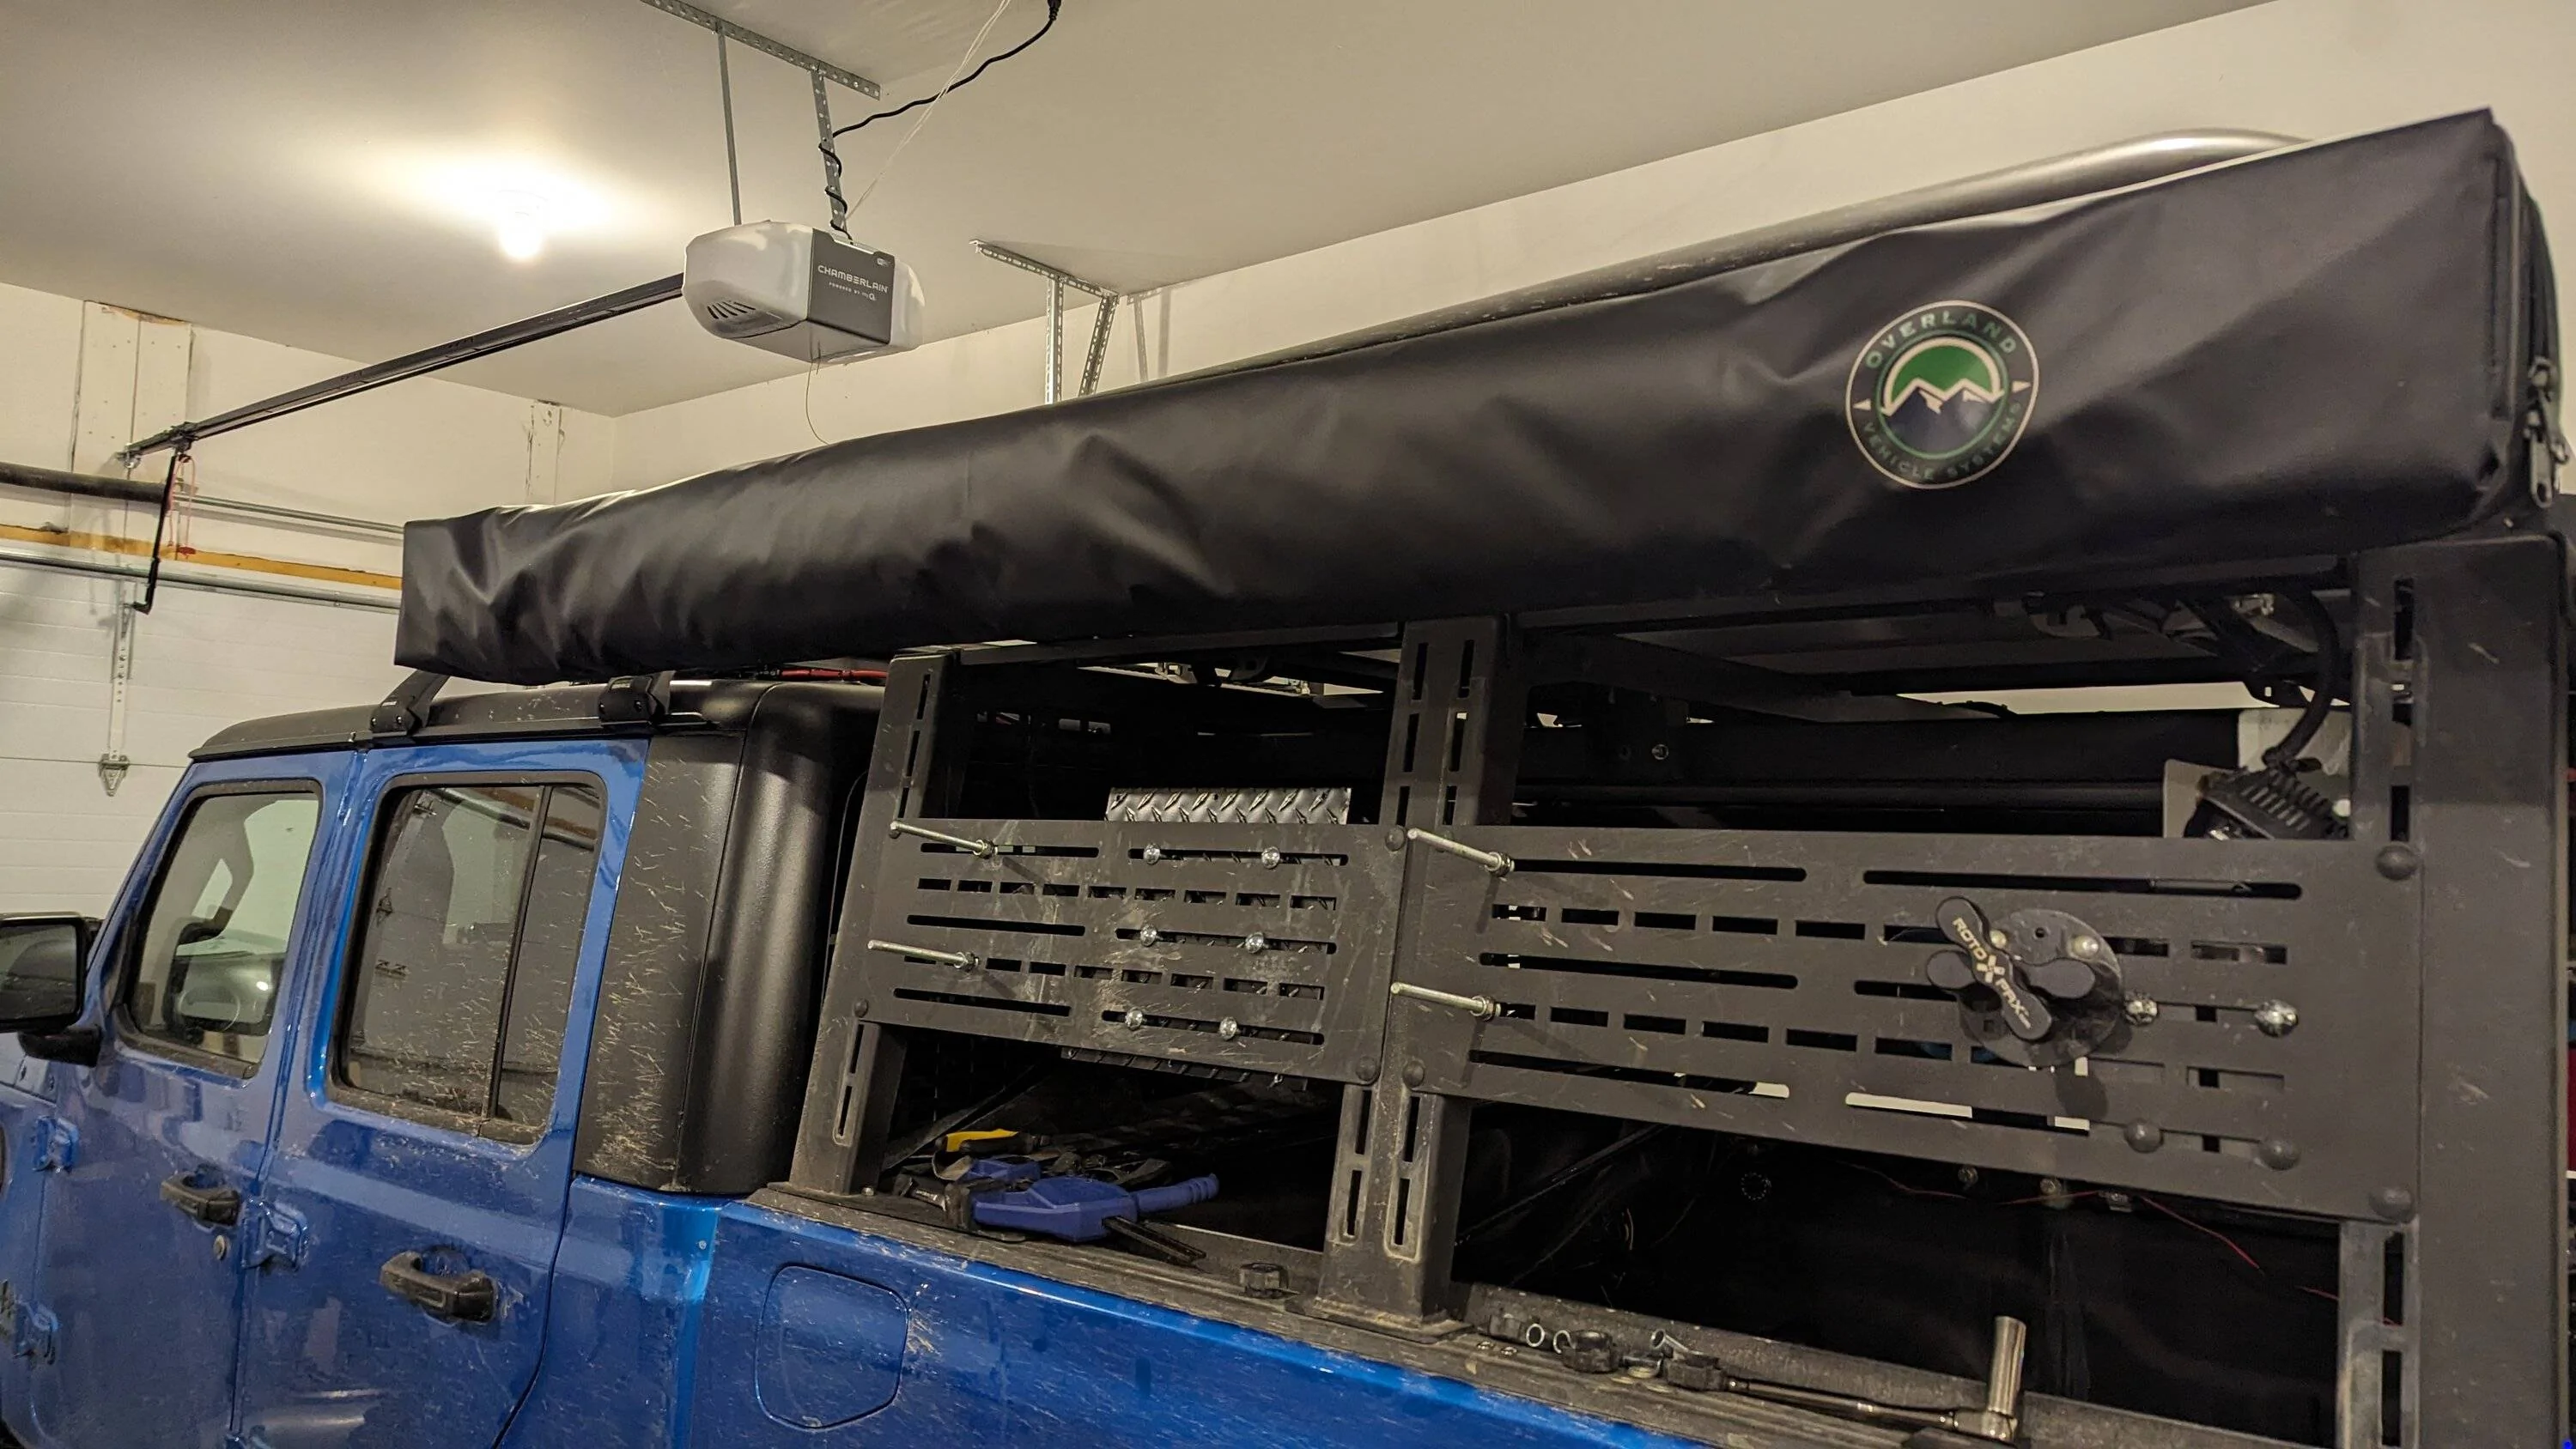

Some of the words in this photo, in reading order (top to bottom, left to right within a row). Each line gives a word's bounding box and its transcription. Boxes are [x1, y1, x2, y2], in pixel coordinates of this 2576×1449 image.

[817, 264, 889, 293] CHAMBERLAIN
[1865, 310, 2017, 369] OVERLAND
[1864, 421, 1935, 480] VEHICLE
[1947, 403, 2022, 477] SYSTEMS
[1952, 917, 1988, 961] ROTO
